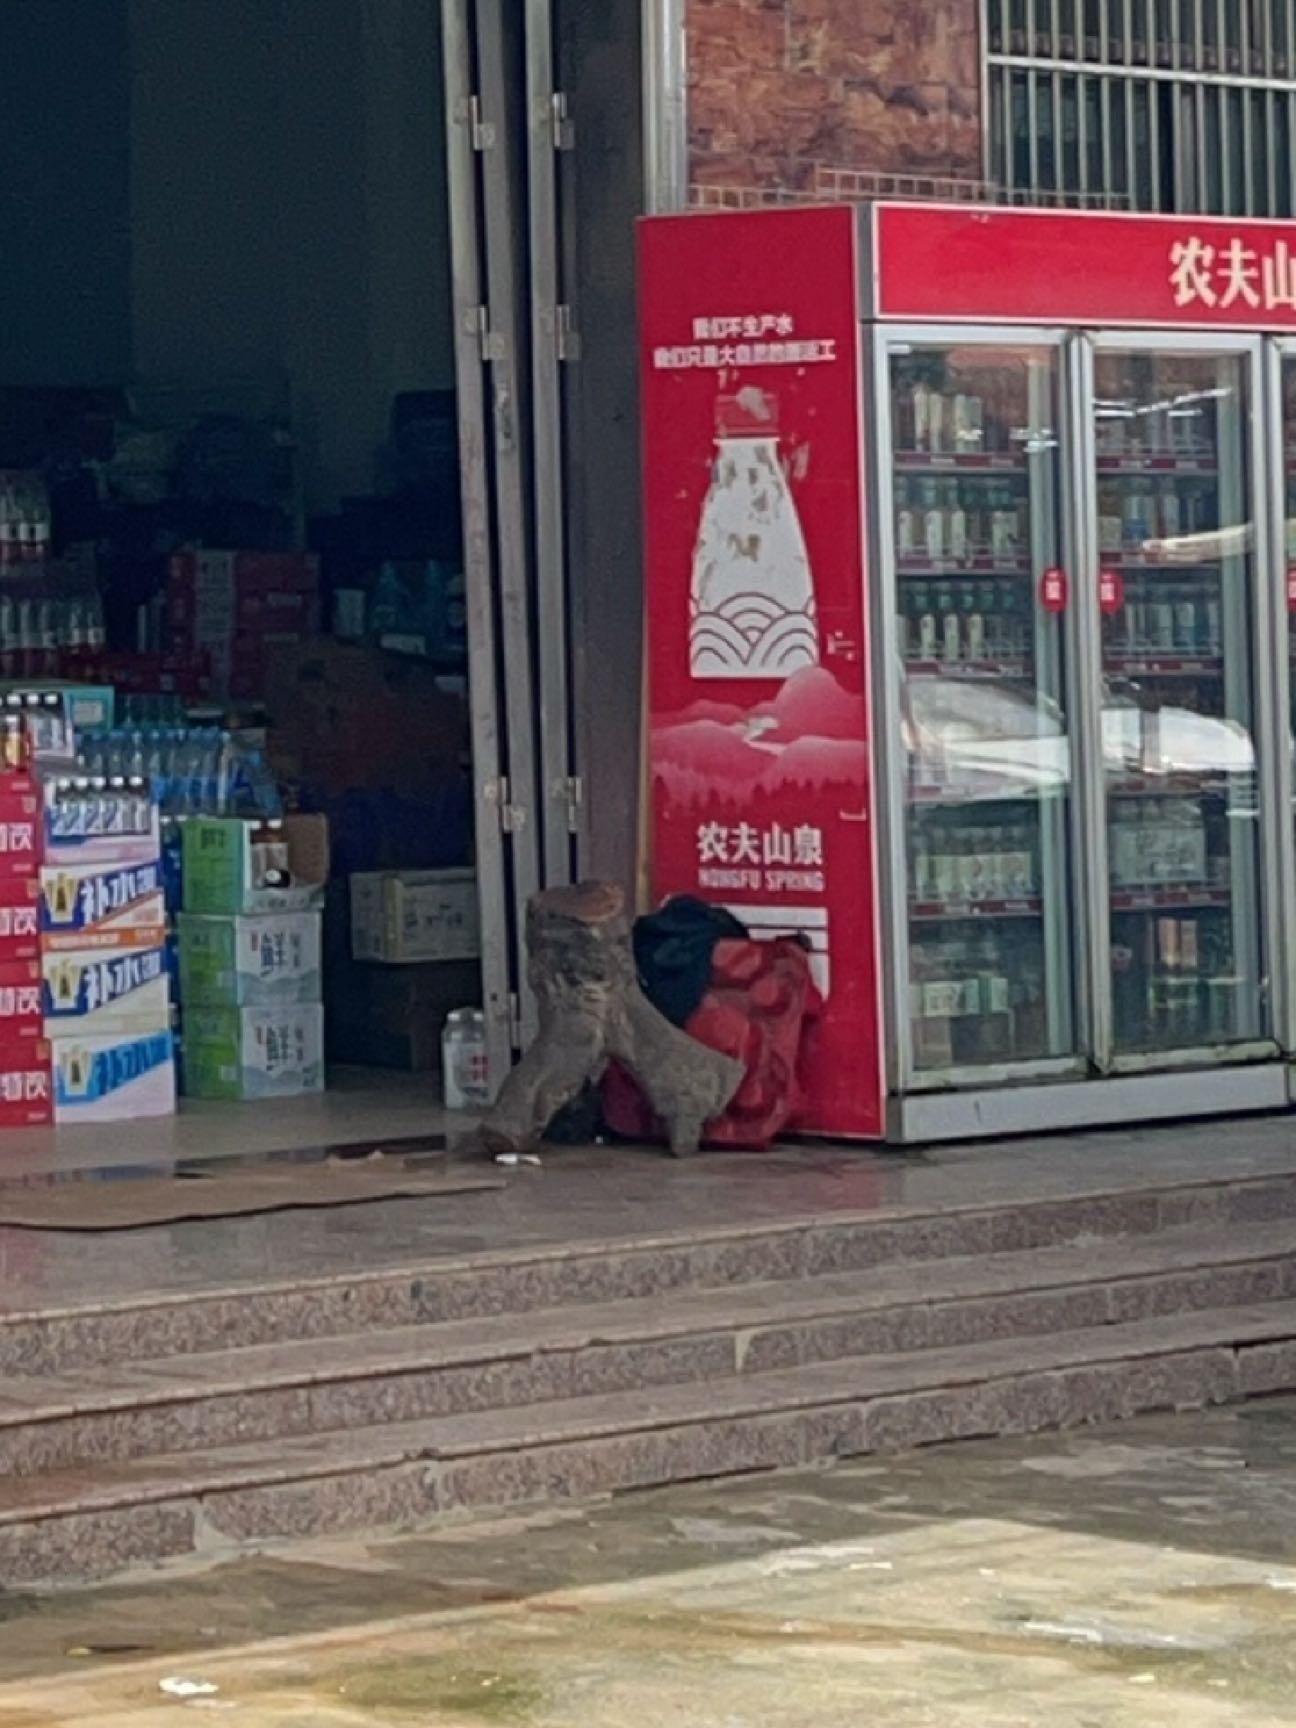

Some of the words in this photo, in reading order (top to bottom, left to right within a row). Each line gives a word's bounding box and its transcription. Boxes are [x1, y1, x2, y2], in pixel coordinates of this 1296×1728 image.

[1168, 236, 1296, 311] 农夫山
[696, 821, 824, 865] 农夫山泉
[765, 870, 825, 892] SPRING
